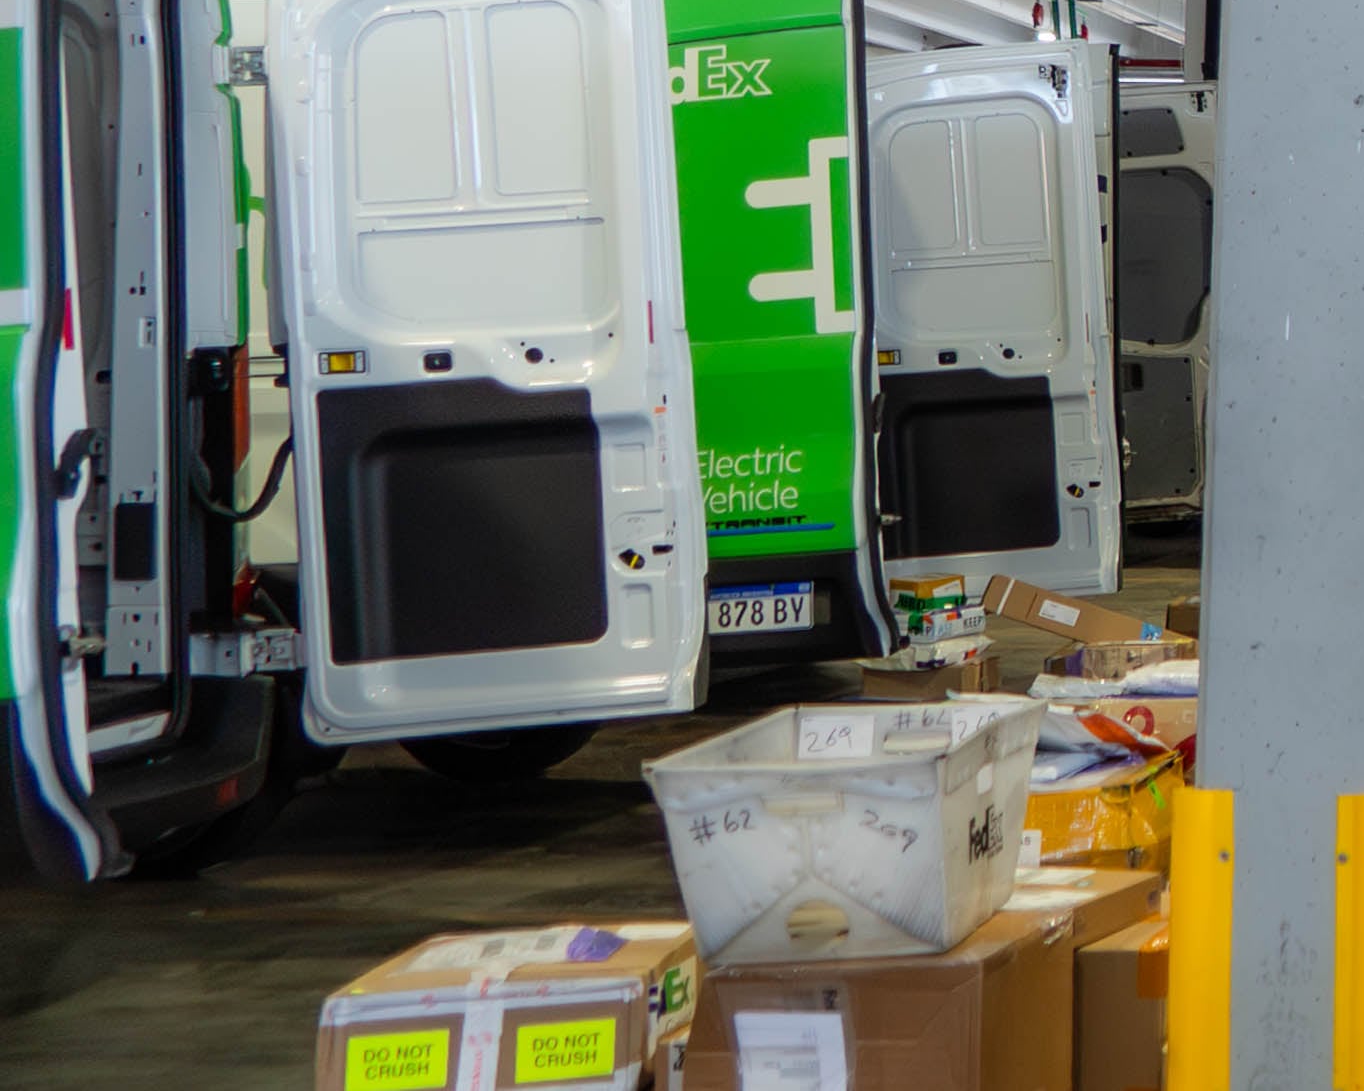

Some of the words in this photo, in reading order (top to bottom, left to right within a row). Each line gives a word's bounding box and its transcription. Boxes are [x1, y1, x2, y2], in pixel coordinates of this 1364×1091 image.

[717, 600, 764, 628] 878
[773, 596, 804, 625] BY
[805, 727, 853, 753] 269
[532, 1037, 559, 1052] DO
[567, 1032, 601, 1048] NOT
[363, 1048, 388, 1063] DO
[396, 1043, 432, 1061] NOT
[534, 1050, 597, 1069] CRUSH
[364, 1062, 431, 1081] CRUSH
